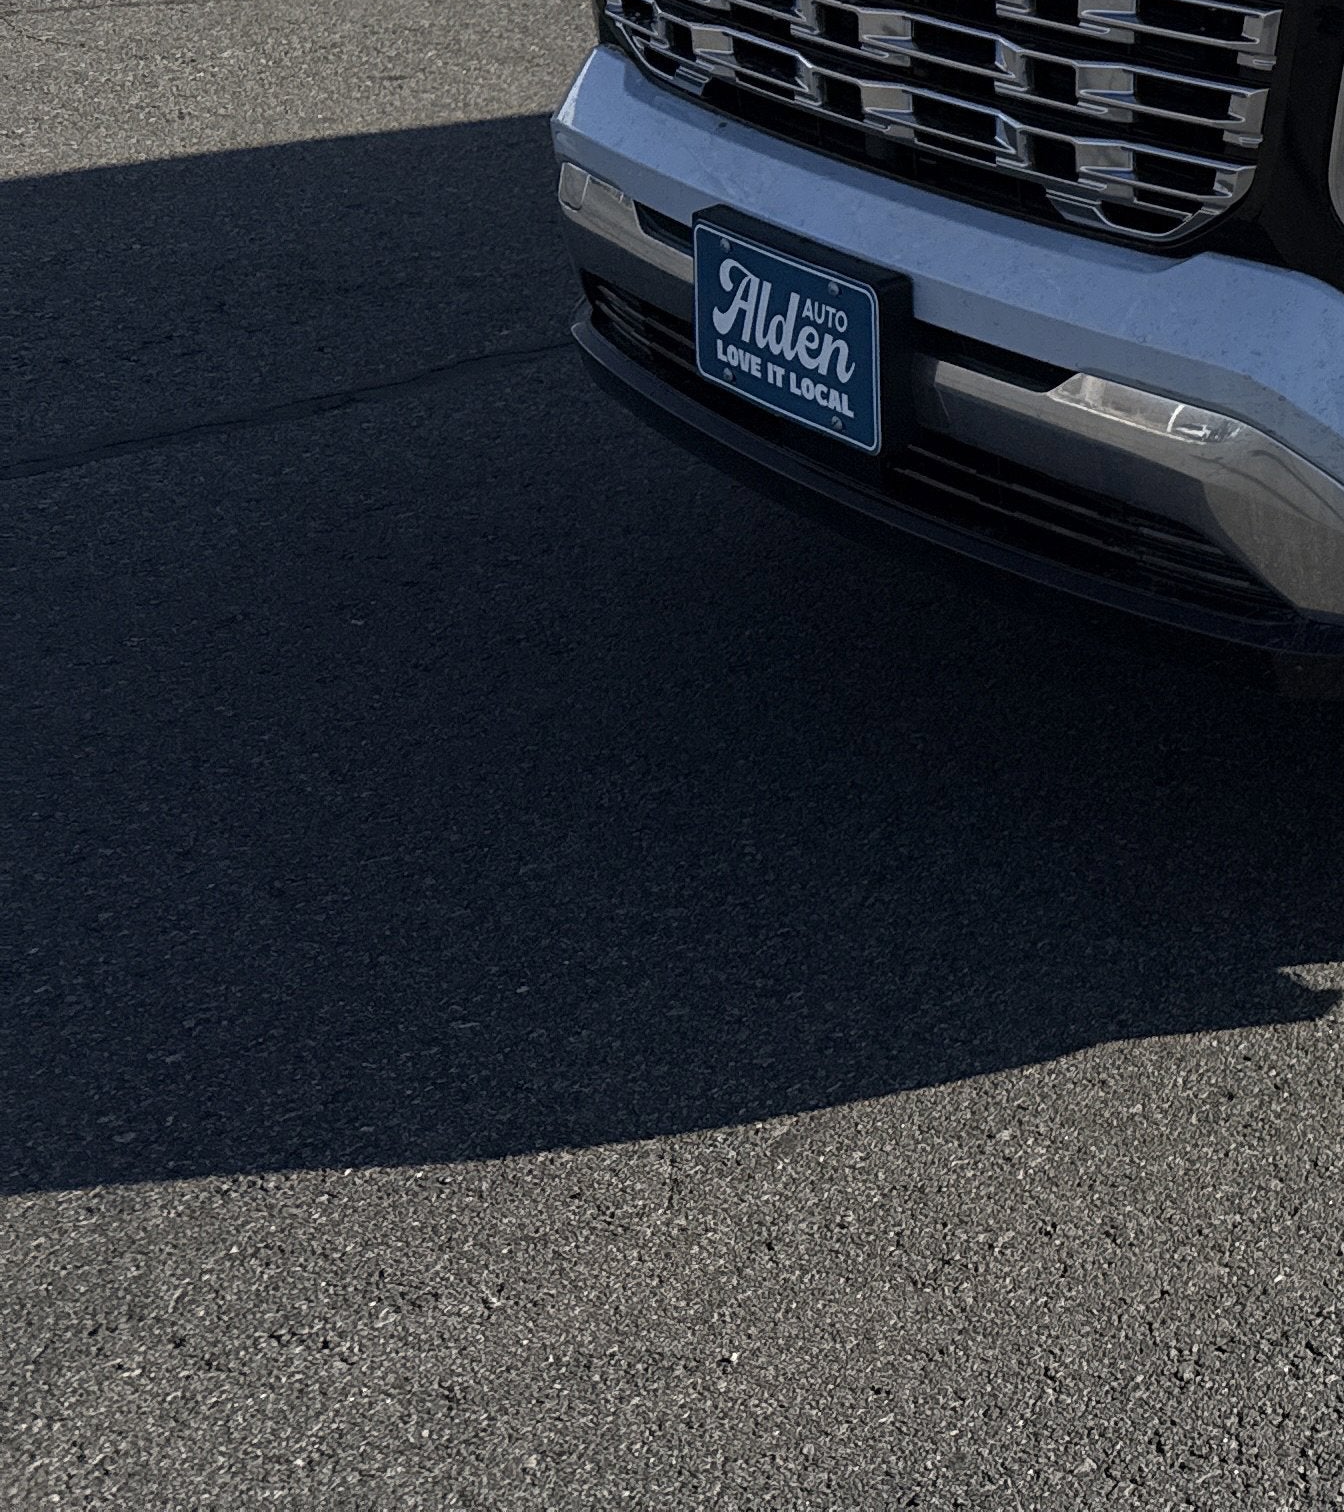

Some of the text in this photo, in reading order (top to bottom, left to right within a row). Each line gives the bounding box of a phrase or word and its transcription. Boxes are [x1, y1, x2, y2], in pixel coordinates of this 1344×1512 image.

[712, 258, 856, 383] Alden
[801, 298, 848, 333] AUTO
[717, 339, 855, 418] LOVE IT LOCAL
